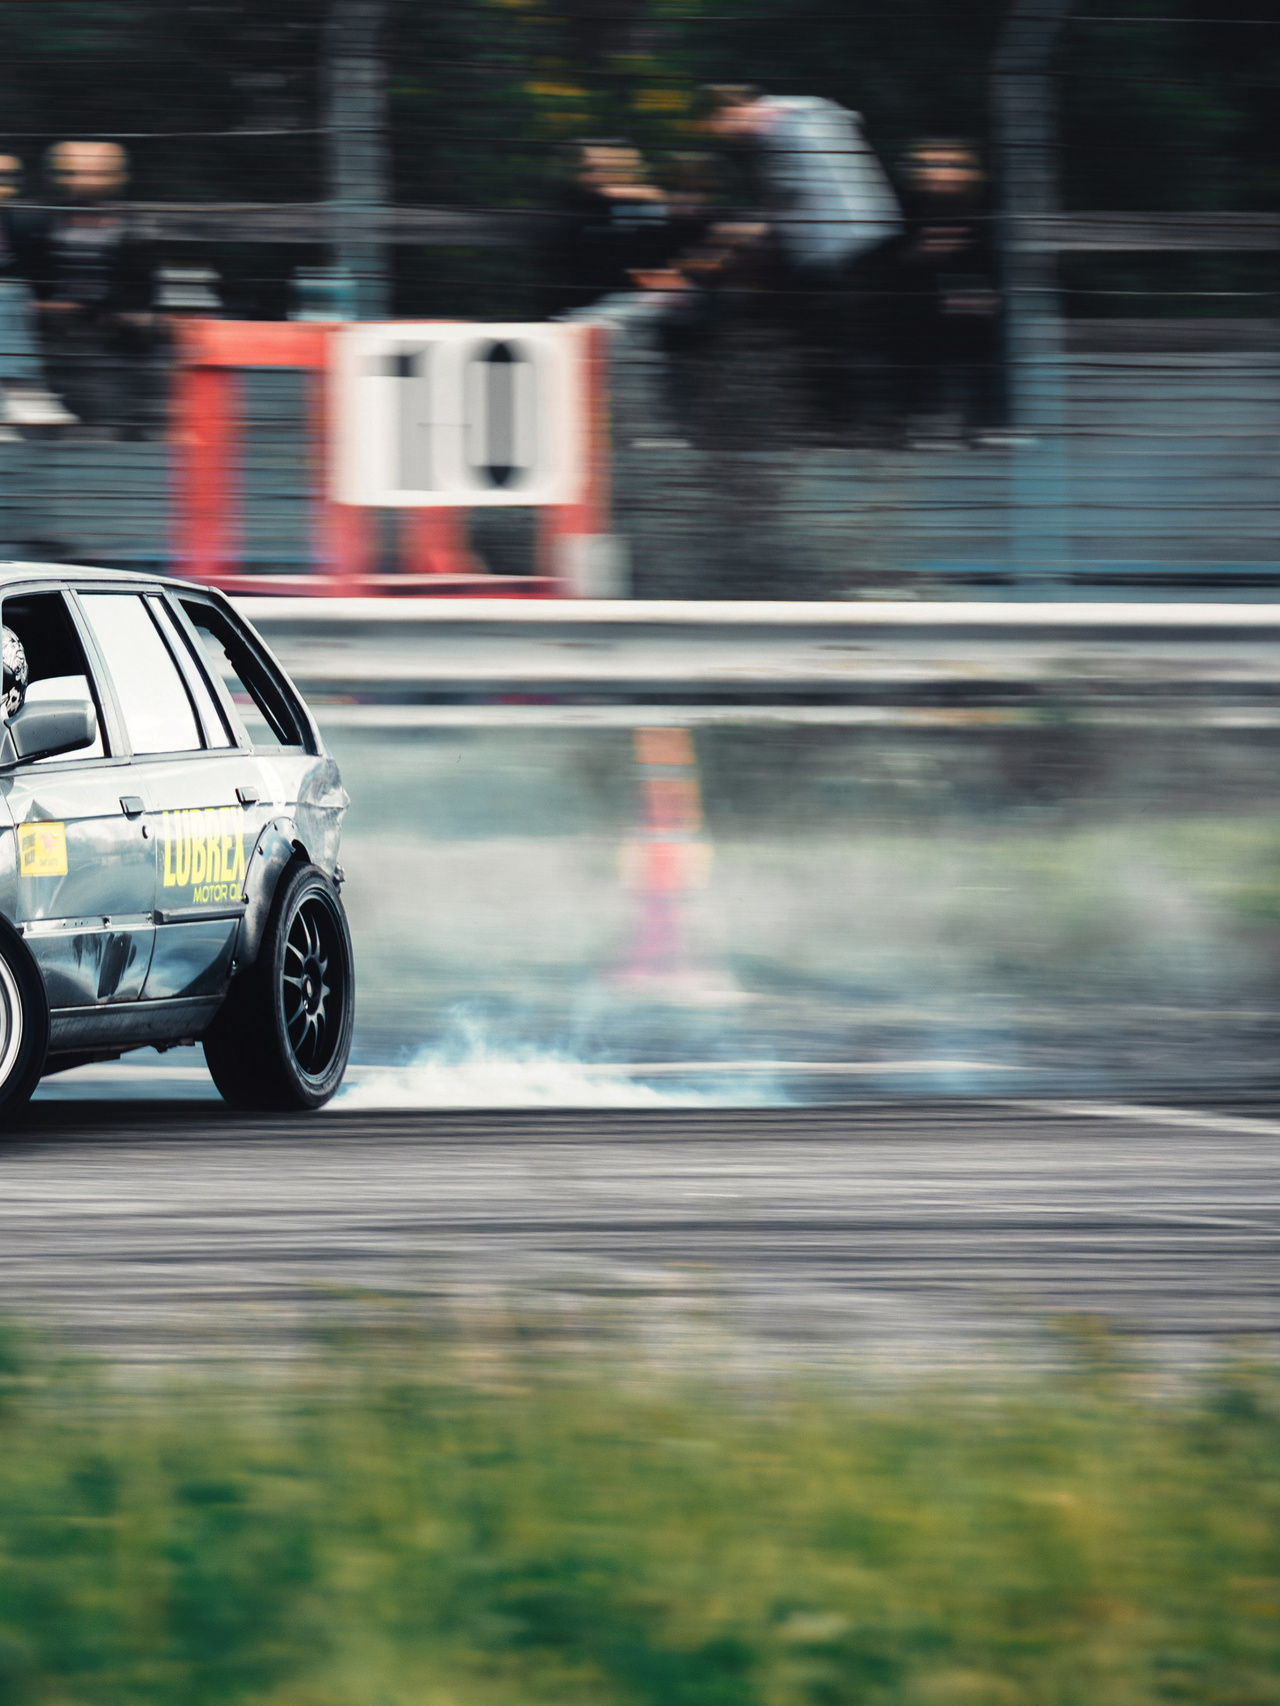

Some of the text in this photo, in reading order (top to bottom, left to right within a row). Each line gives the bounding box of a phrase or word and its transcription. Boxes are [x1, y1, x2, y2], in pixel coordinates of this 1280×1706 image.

[362, 338, 538, 493] 10
[162, 806, 246, 888] LUBREX
[193, 884, 229, 904] MOTOR
